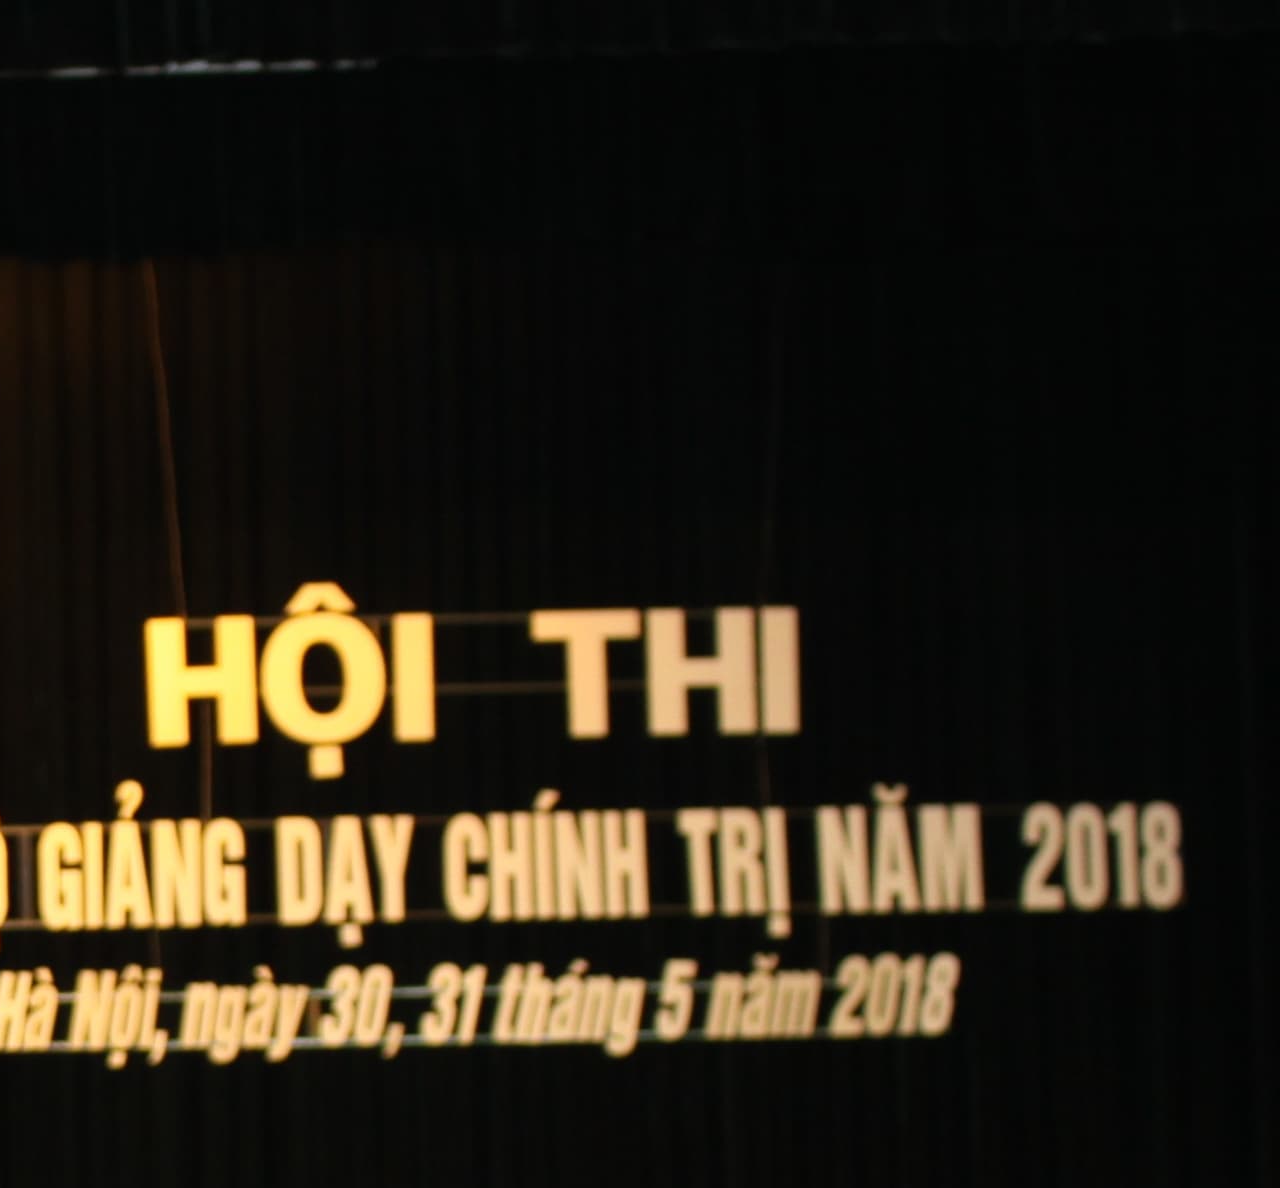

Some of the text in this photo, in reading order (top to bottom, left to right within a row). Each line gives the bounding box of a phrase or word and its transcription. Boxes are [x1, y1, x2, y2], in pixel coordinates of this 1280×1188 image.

[144, 582, 801, 779] HỘI THI
[39, 780, 248, 931] GIẢNG
[275, 814, 414, 948] DẠY
[442, 789, 649, 922] CHÍNH
[677, 807, 791, 938] TRỊ
[816, 782, 985, 915] NĂM
[1020, 801, 1184, 912] 2018
[66, 965, 167, 1070] Nội,
[180, 965, 310, 1064] ngày
[318, 964, 403, 1058] 30,
[420, 963, 487, 1045] 31
[491, 960, 645, 1058] tháng
[653, 958, 698, 1041] 5
[704, 953, 822, 1040] năm
[829, 952, 961, 1037] 2018
